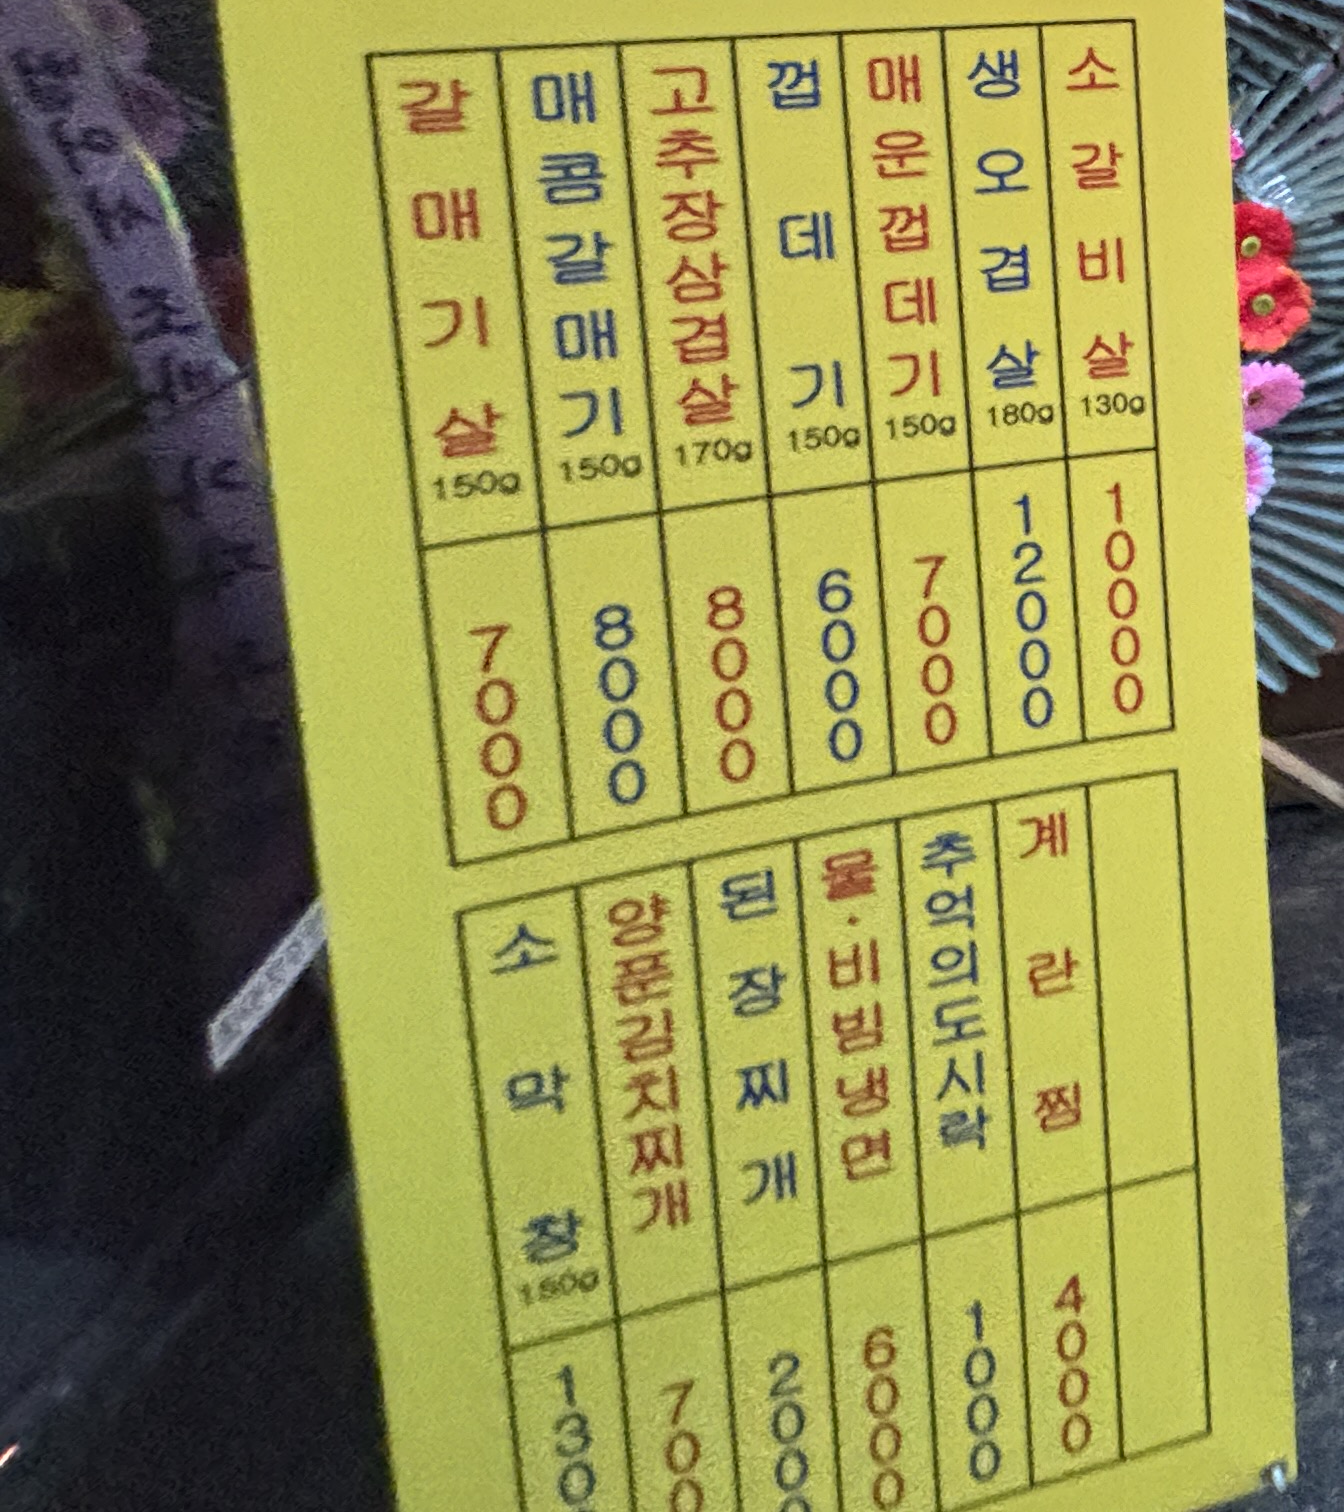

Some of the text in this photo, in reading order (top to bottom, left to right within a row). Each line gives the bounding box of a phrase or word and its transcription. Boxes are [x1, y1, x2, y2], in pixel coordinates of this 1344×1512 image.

[398, 79, 505, 459] 갈매기살
[530, 70, 625, 439] 매콤갈매기
[650, 66, 740, 427] 고추장삼겹살
[766, 58, 845, 409] 껍데기
[866, 54, 941, 397] 매운껍데기
[966, 49, 1041, 391] 생오겹살
[1066, 47, 1135, 380] 소갈비살
[559, 453, 644, 483] 150g
[675, 437, 754, 466] 170g
[788, 424, 861, 452] 150g
[885, 413, 957, 440] 150g
[987, 401, 1055, 427] 180g
[1081, 392, 1146, 417] 130g
[706, 585, 756, 784] 8000
[816, 568, 863, 764] 6000
[913, 554, 959, 746] 7000
[1012, 492, 1056, 729] 12000
[1104, 482, 1145, 716] 10000
[468, 624, 529, 831] 7000
[593, 603, 649, 806] 8000
[608, 891, 692, 1233] 양푼김치찌개
[718, 866, 797, 1206] 된장찌개
[920, 831, 993, 1151] 추억의도시락
[1019, 808, 1082, 1133] 계란찜
[490, 921, 584, 1265] 소막창
[551, 1364, 598, 1511] 130
[862, 1324, 906, 1511] 6000
[963, 1299, 1002, 1484] 1000
[1054, 1273, 1093, 1457] 4000
